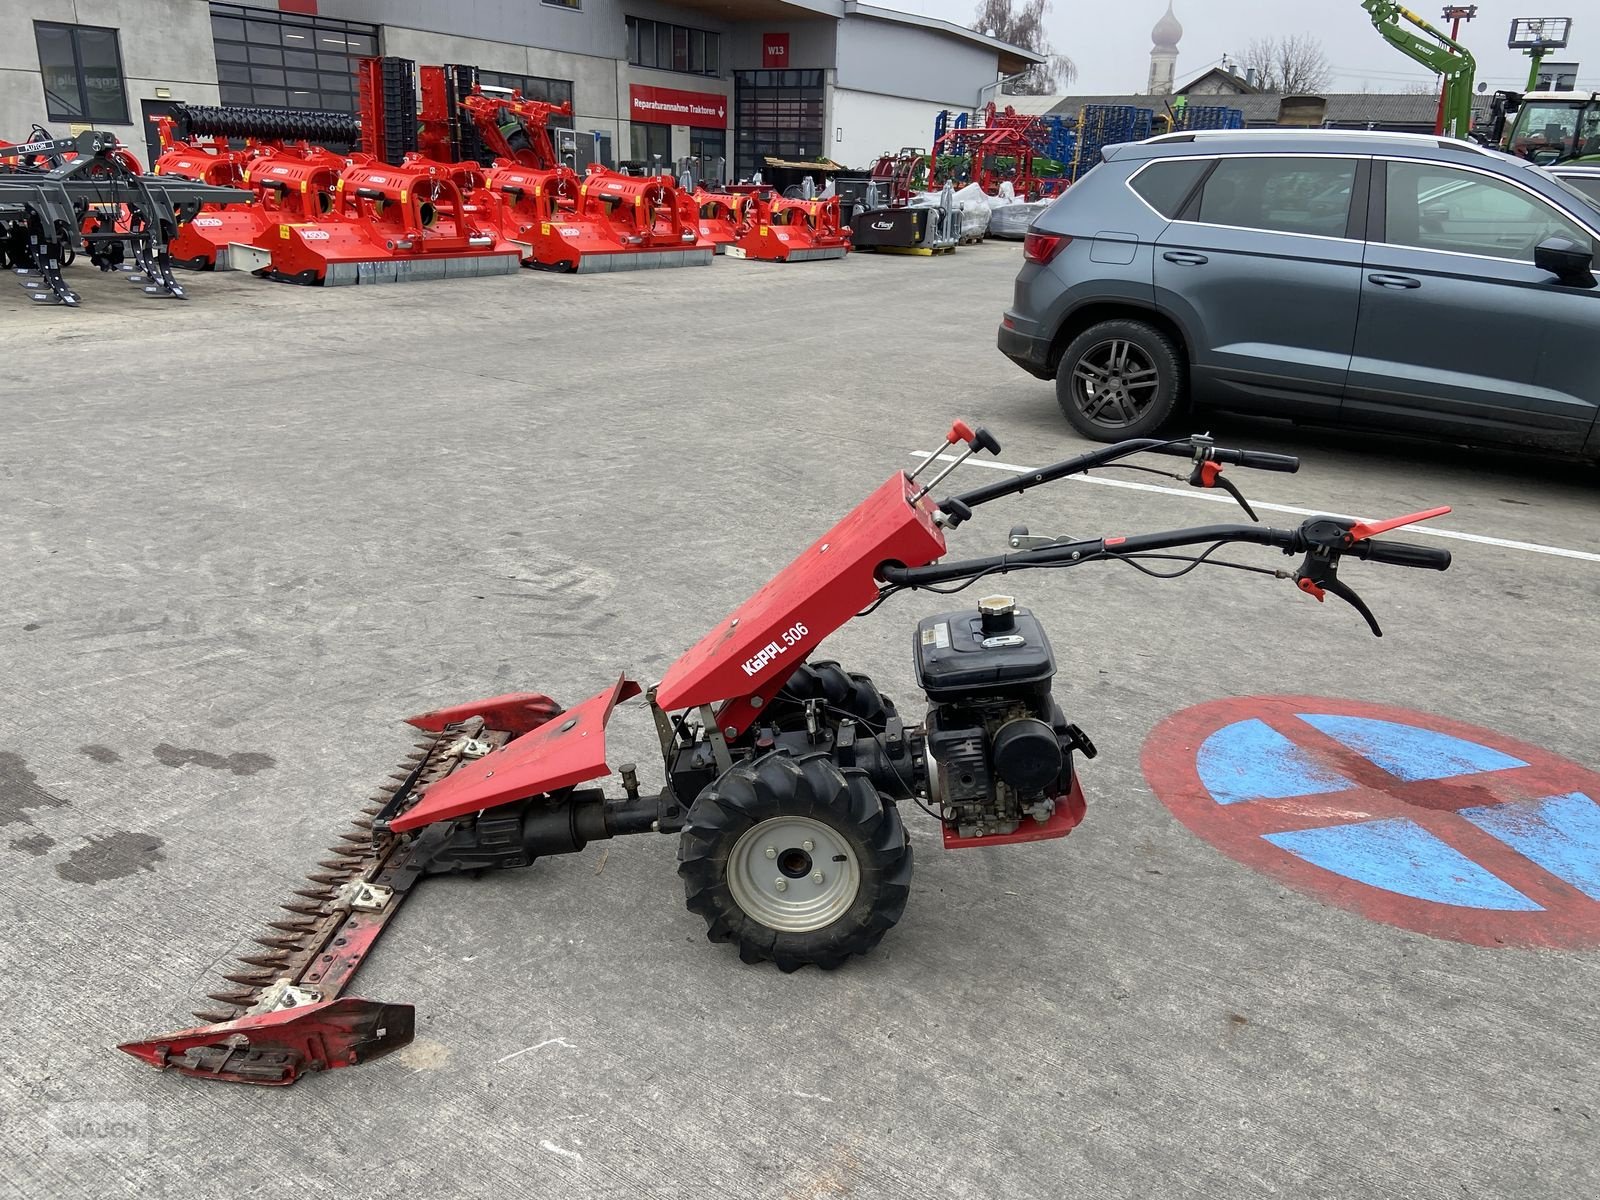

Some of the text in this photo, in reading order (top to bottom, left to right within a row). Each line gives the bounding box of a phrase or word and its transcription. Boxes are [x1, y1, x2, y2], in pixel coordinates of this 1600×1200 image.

[768, 46, 785, 55] W13
[1415, 43, 1435, 55] FENDT
[634, 97, 716, 115] Reparaturannahme Traktoren
[781, 622, 809, 646] 506
